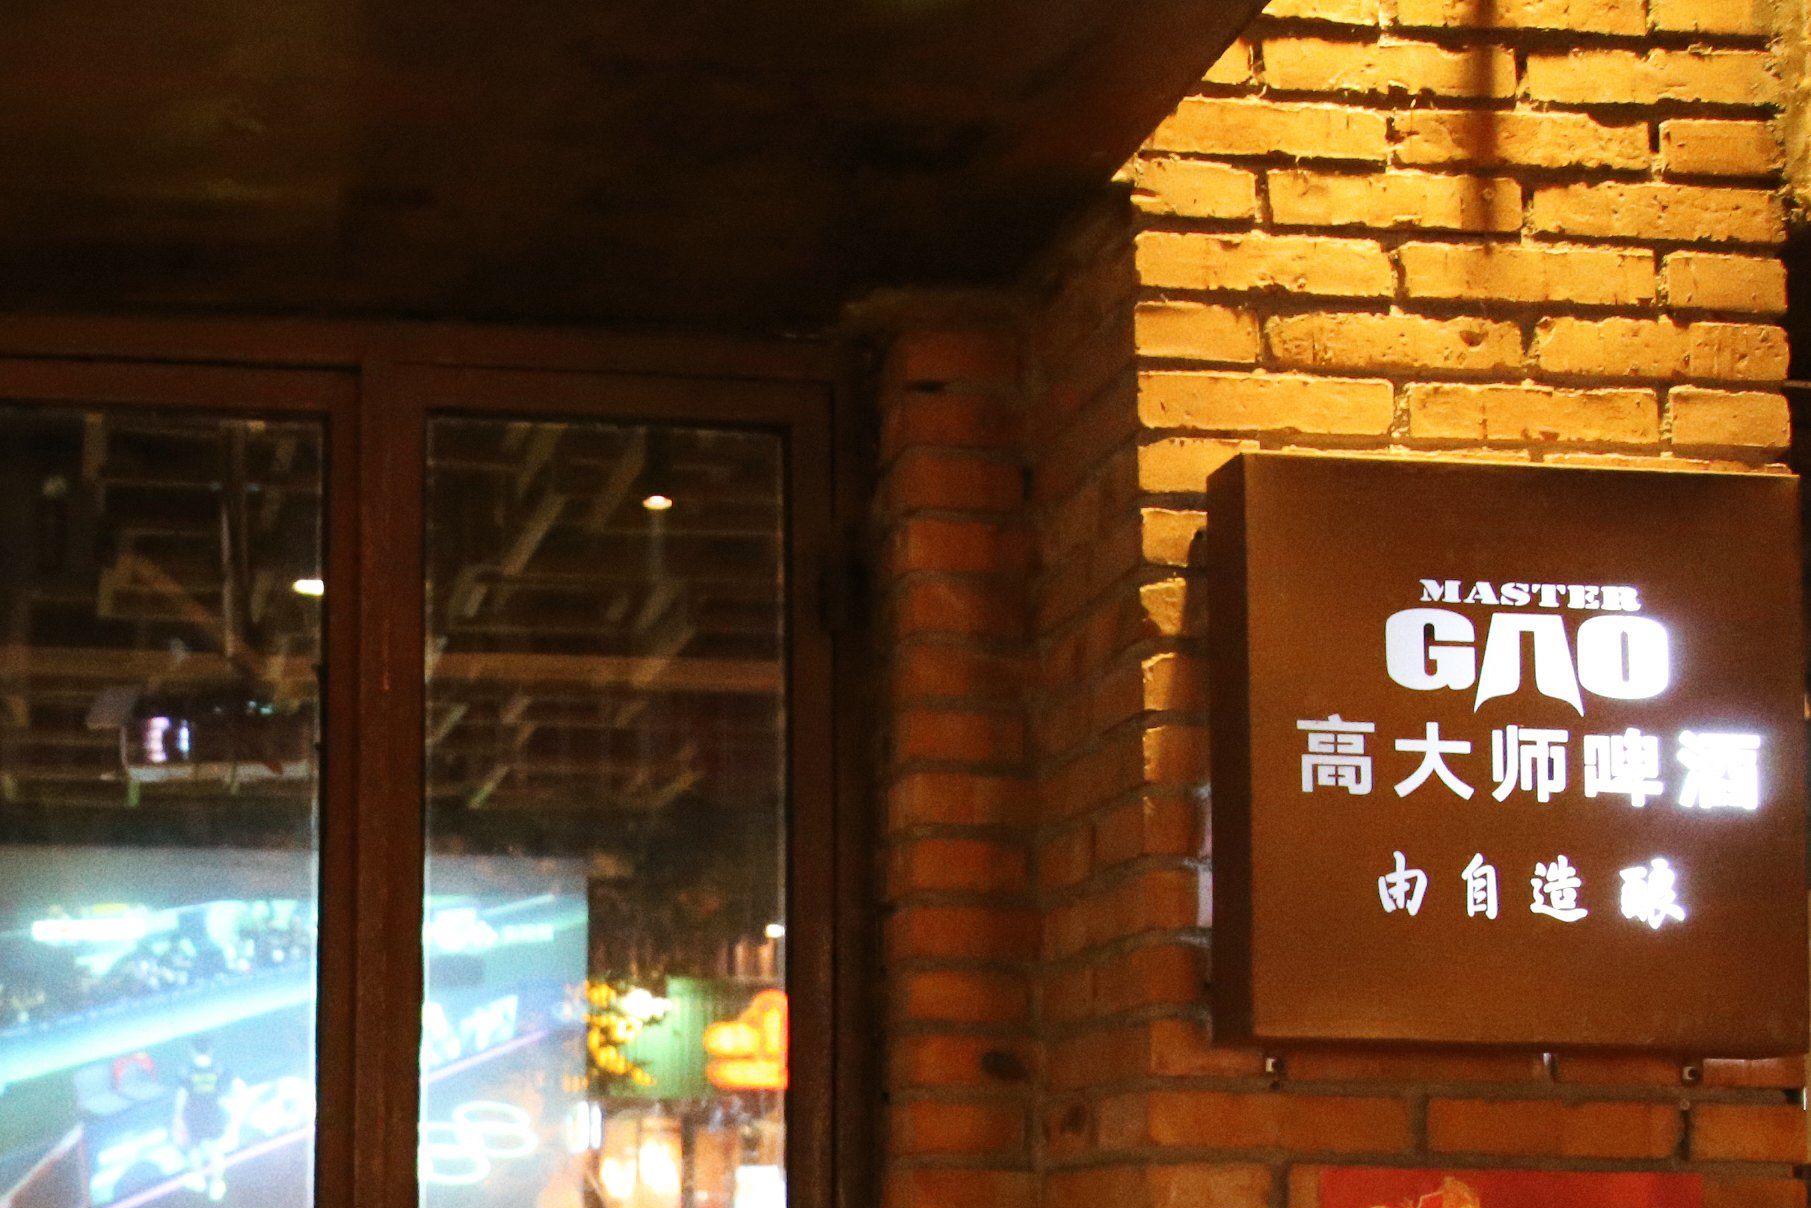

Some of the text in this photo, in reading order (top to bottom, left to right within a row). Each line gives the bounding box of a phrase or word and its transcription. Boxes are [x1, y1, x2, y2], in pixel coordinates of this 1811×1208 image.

[1419, 578, 1641, 611] MASTER
[1385, 607, 1669, 717] GAO
[1296, 714, 1761, 810] 高大师啤酒
